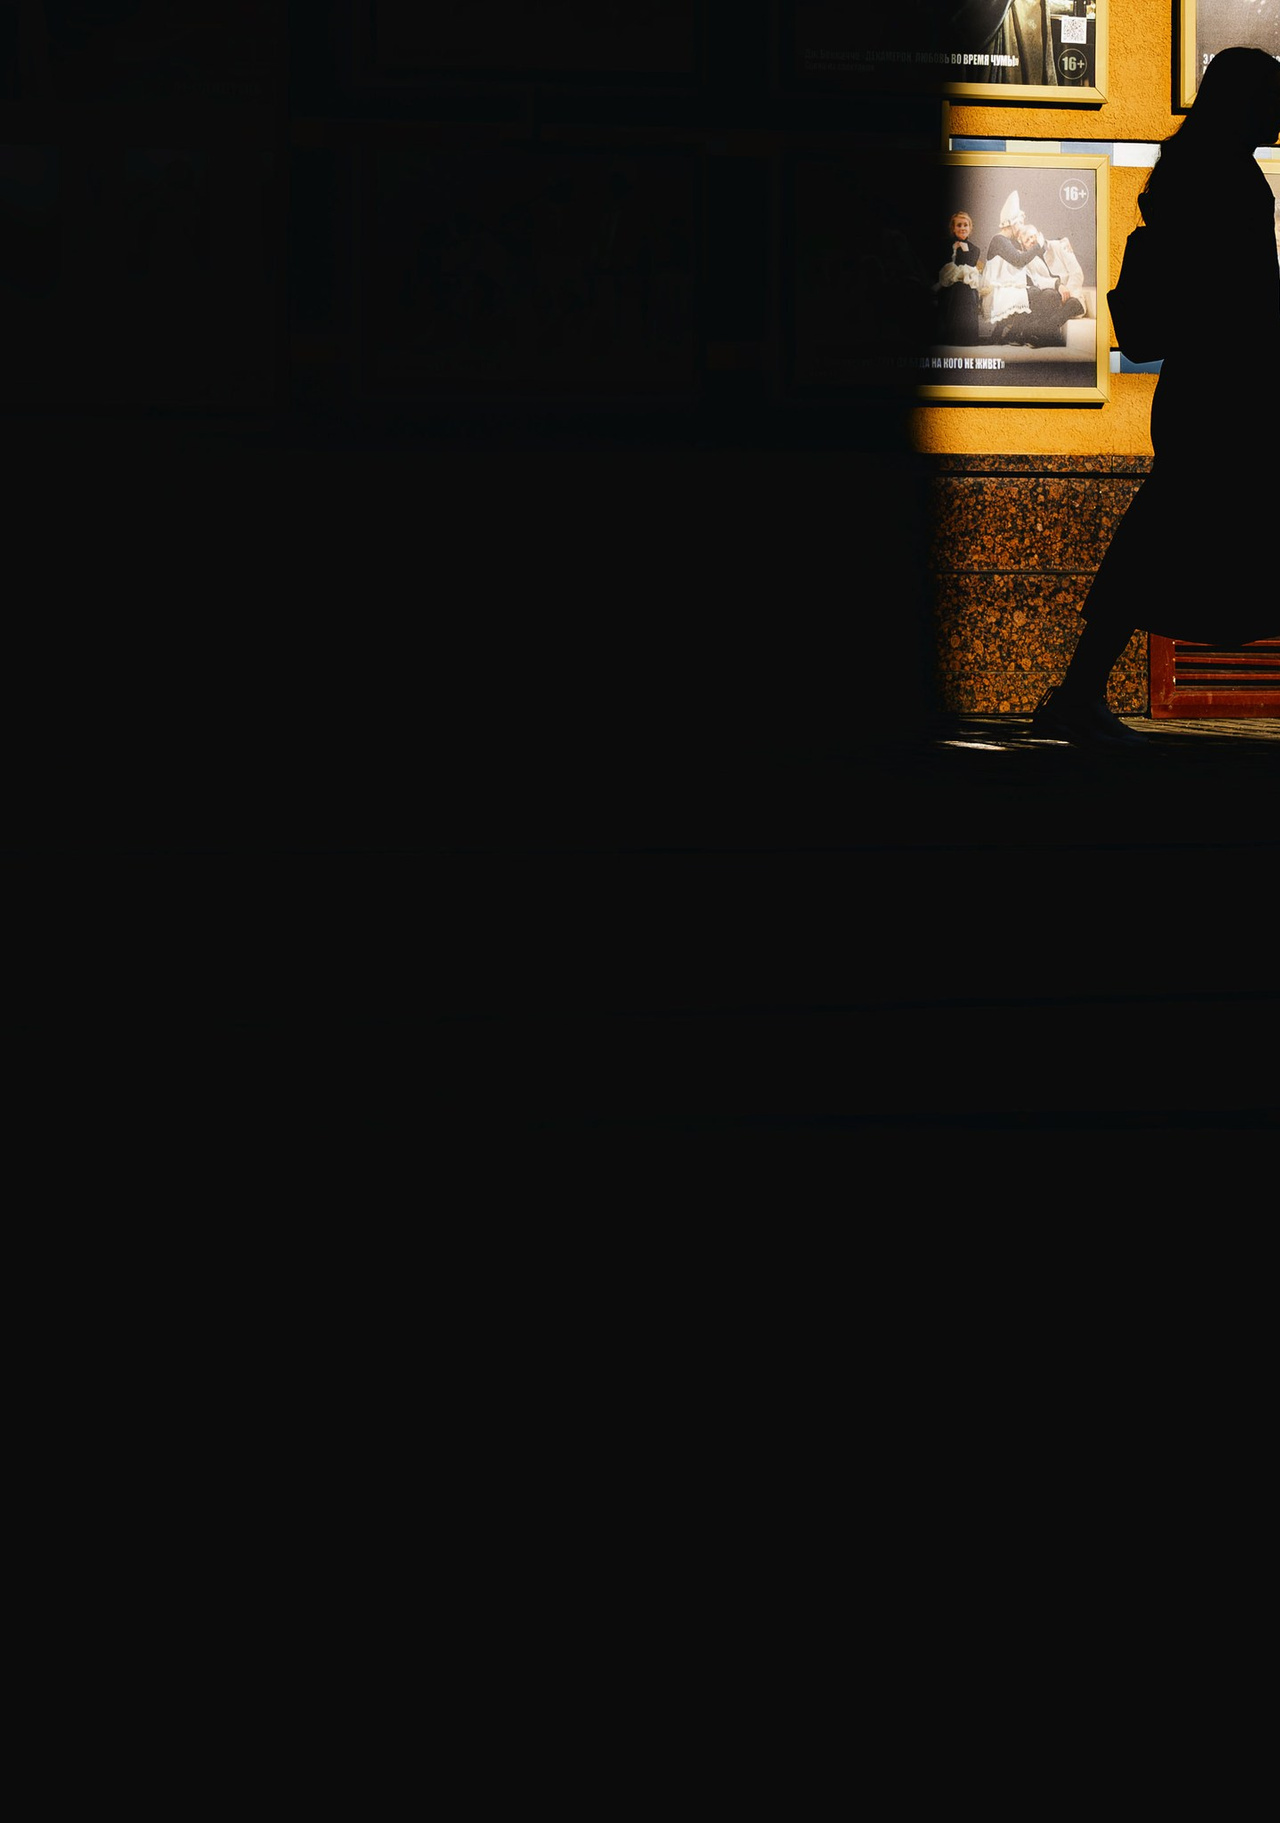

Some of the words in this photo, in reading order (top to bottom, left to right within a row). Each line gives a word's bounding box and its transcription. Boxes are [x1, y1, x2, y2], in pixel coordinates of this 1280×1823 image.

[951, 54, 961, 64] ВО
[963, 54, 990, 66] ВРЕМЯ
[1062, 56, 1085, 71] 16+
[1063, 186, 1087, 201] 16+
[943, 358, 962, 368] КОГО
[964, 358, 974, 369] НЕ
